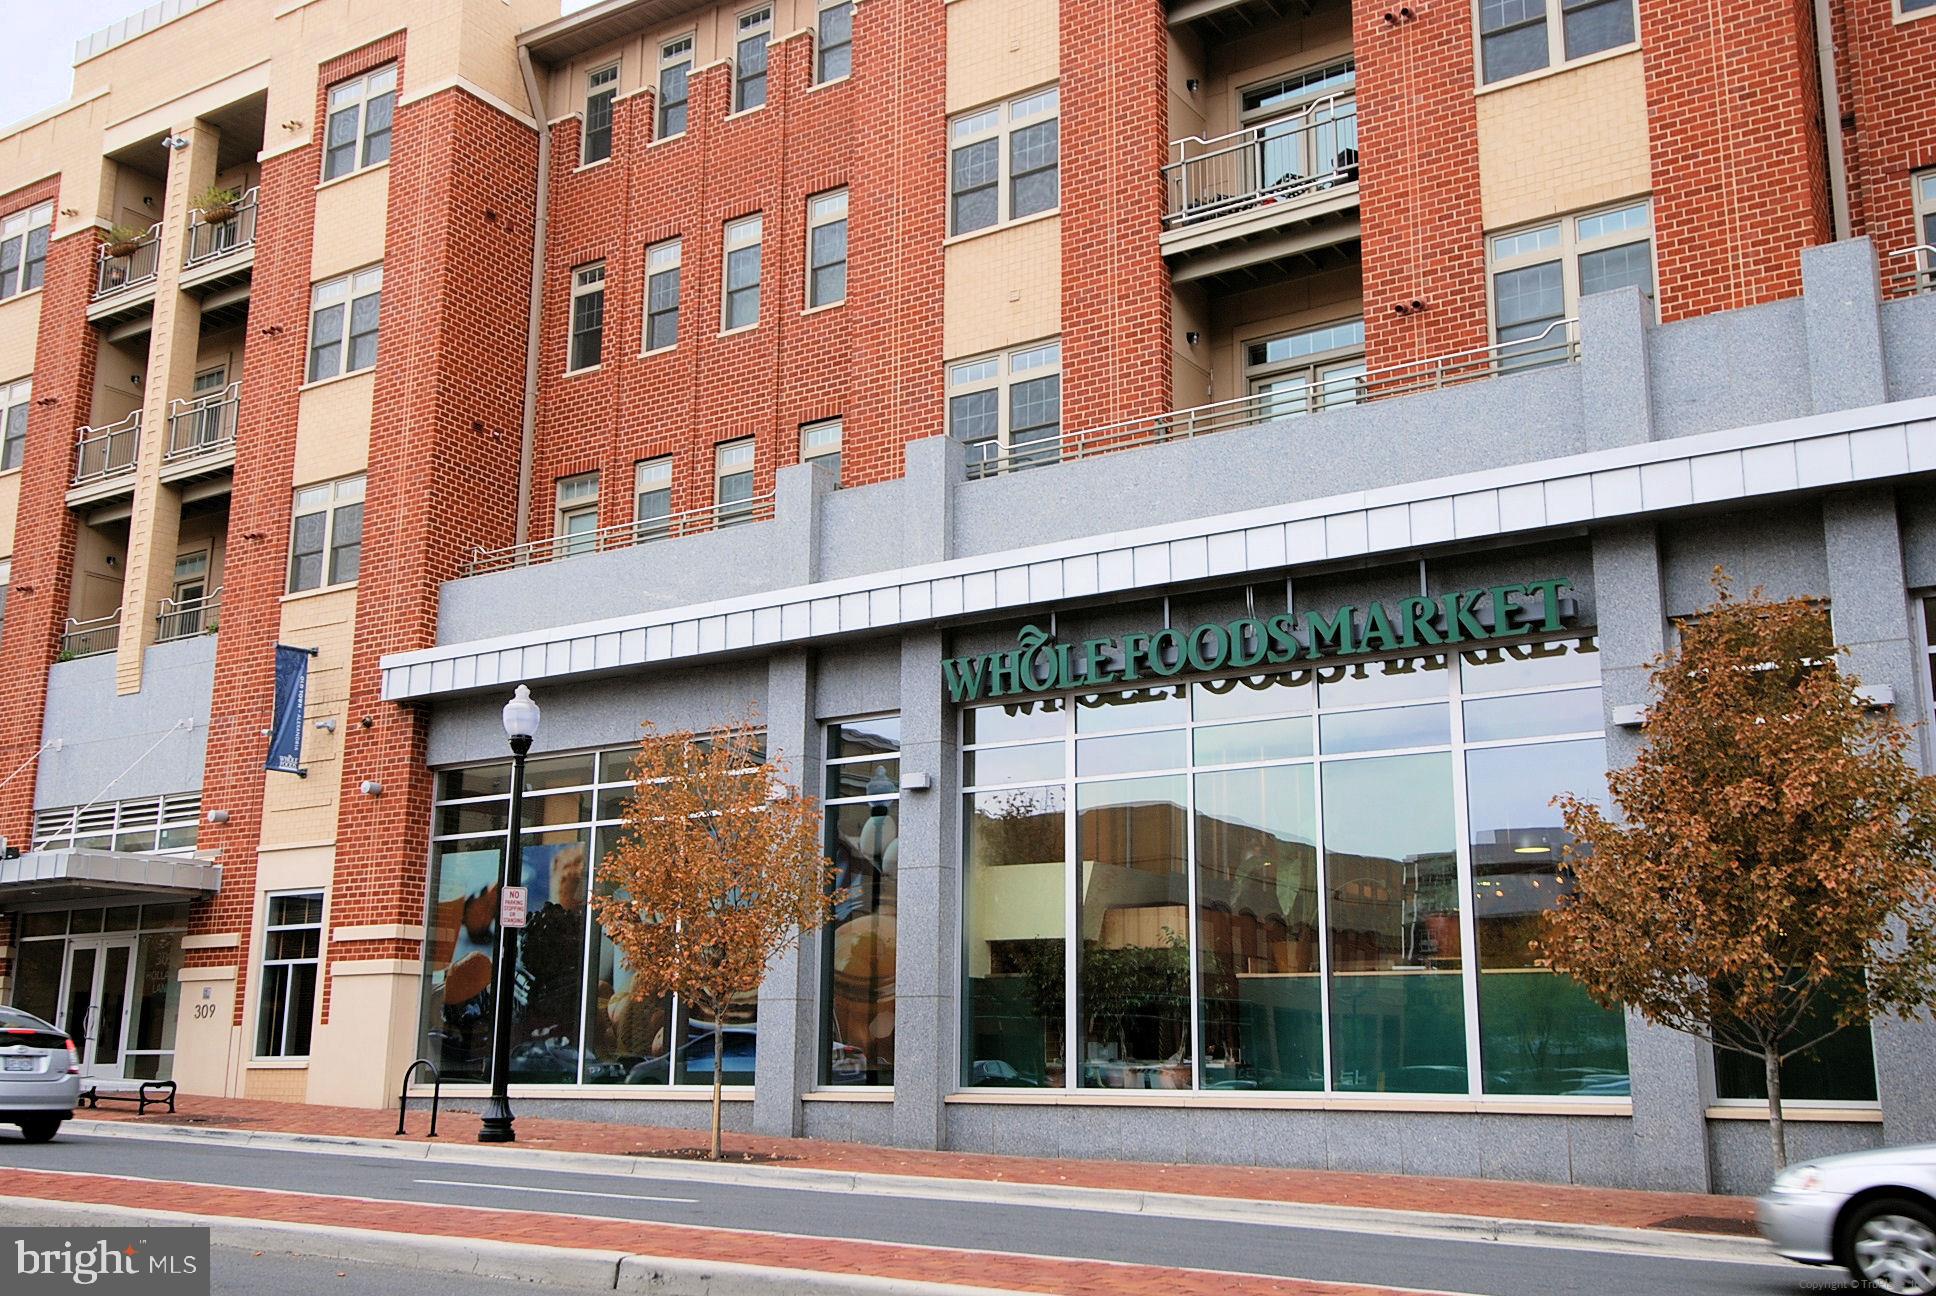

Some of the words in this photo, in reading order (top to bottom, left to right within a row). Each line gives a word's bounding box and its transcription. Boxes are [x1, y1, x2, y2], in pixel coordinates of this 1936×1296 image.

[941, 624, 1116, 703] WHOLE
[1120, 612, 1299, 681] FOODS
[1302, 577, 1575, 660] MARKET
[293, 713, 302, 751] ALEXANDRIA
[509, 890, 520, 899] NO
[194, 1004, 216, 1019] 309
